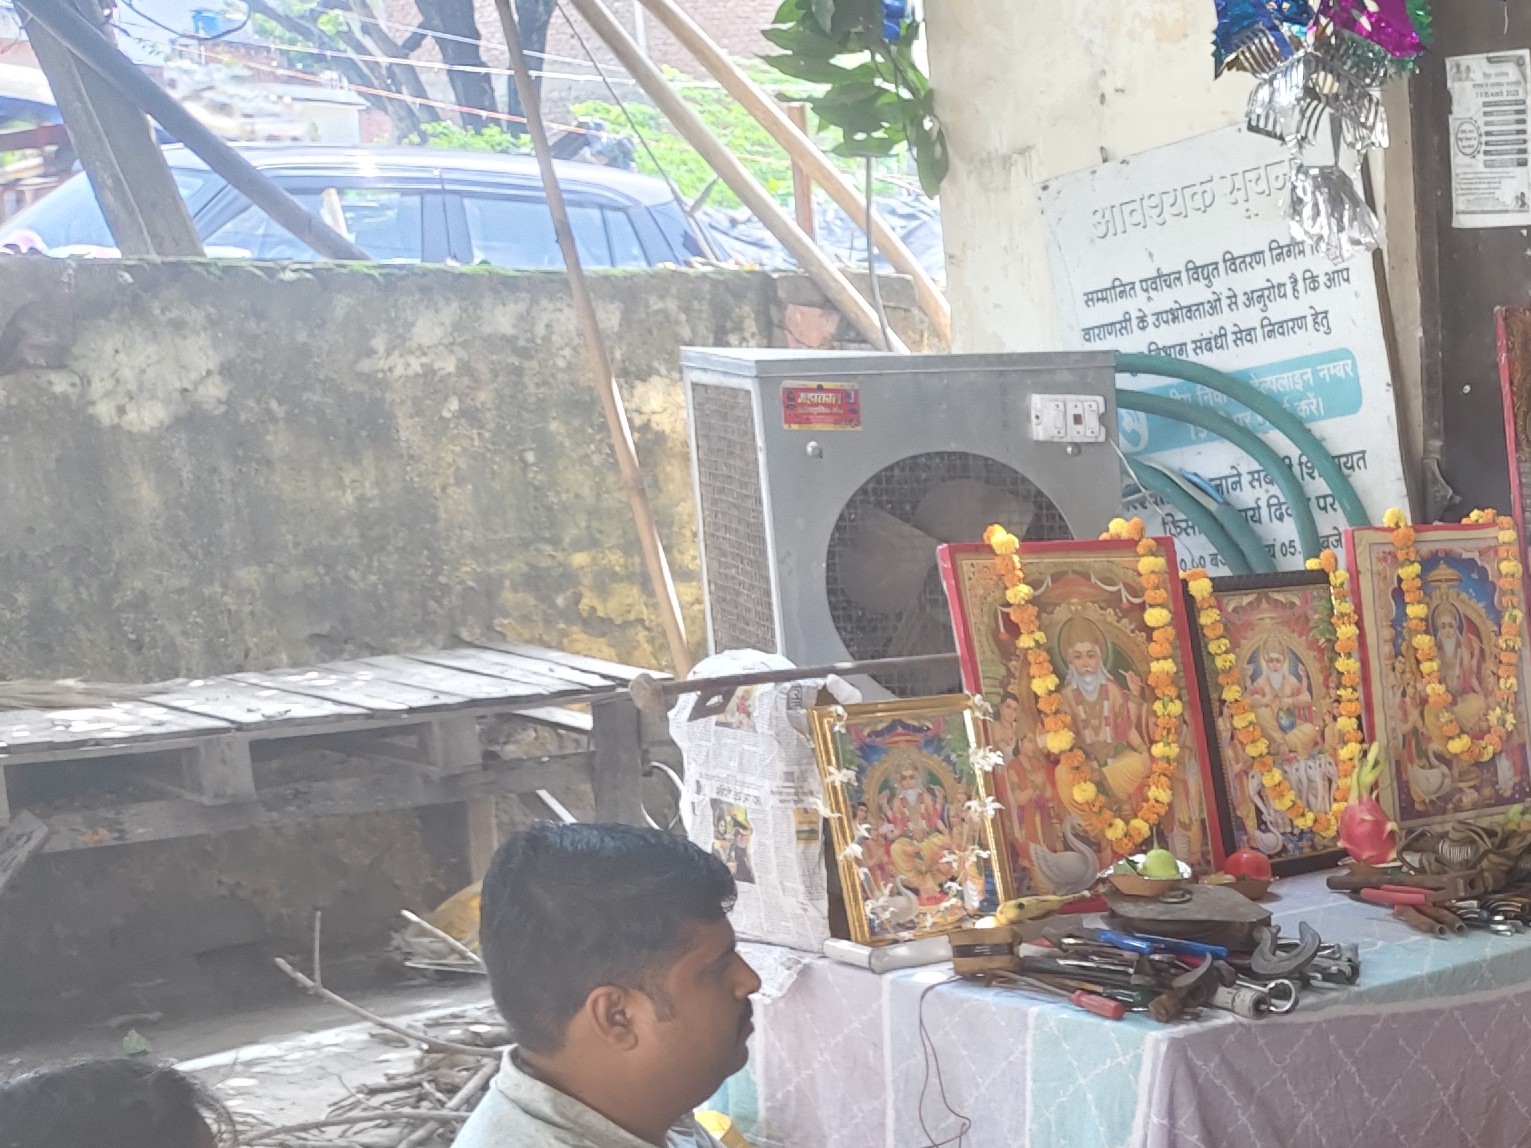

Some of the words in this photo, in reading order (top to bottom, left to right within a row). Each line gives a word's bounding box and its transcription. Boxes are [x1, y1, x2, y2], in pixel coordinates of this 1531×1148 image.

[1185, 259, 1221, 288] विद्युत
[1223, 251, 1266, 276] वितरण
[1269, 240, 1306, 265] निगम
[1082, 312, 1134, 344] वाराणसी
[1135, 308, 1149, 331] के
[1226, 288, 1239, 312] से
[1243, 279, 1287, 312] अनुरोध
[1289, 273, 1300, 300] है
[1303, 269, 1320, 294] कि
[1323, 268, 1350, 289] आप
[1231, 324, 1257, 348] सेवा
[1260, 316, 1308, 341] निवारण
[1309, 306, 1332, 335] हेतु
